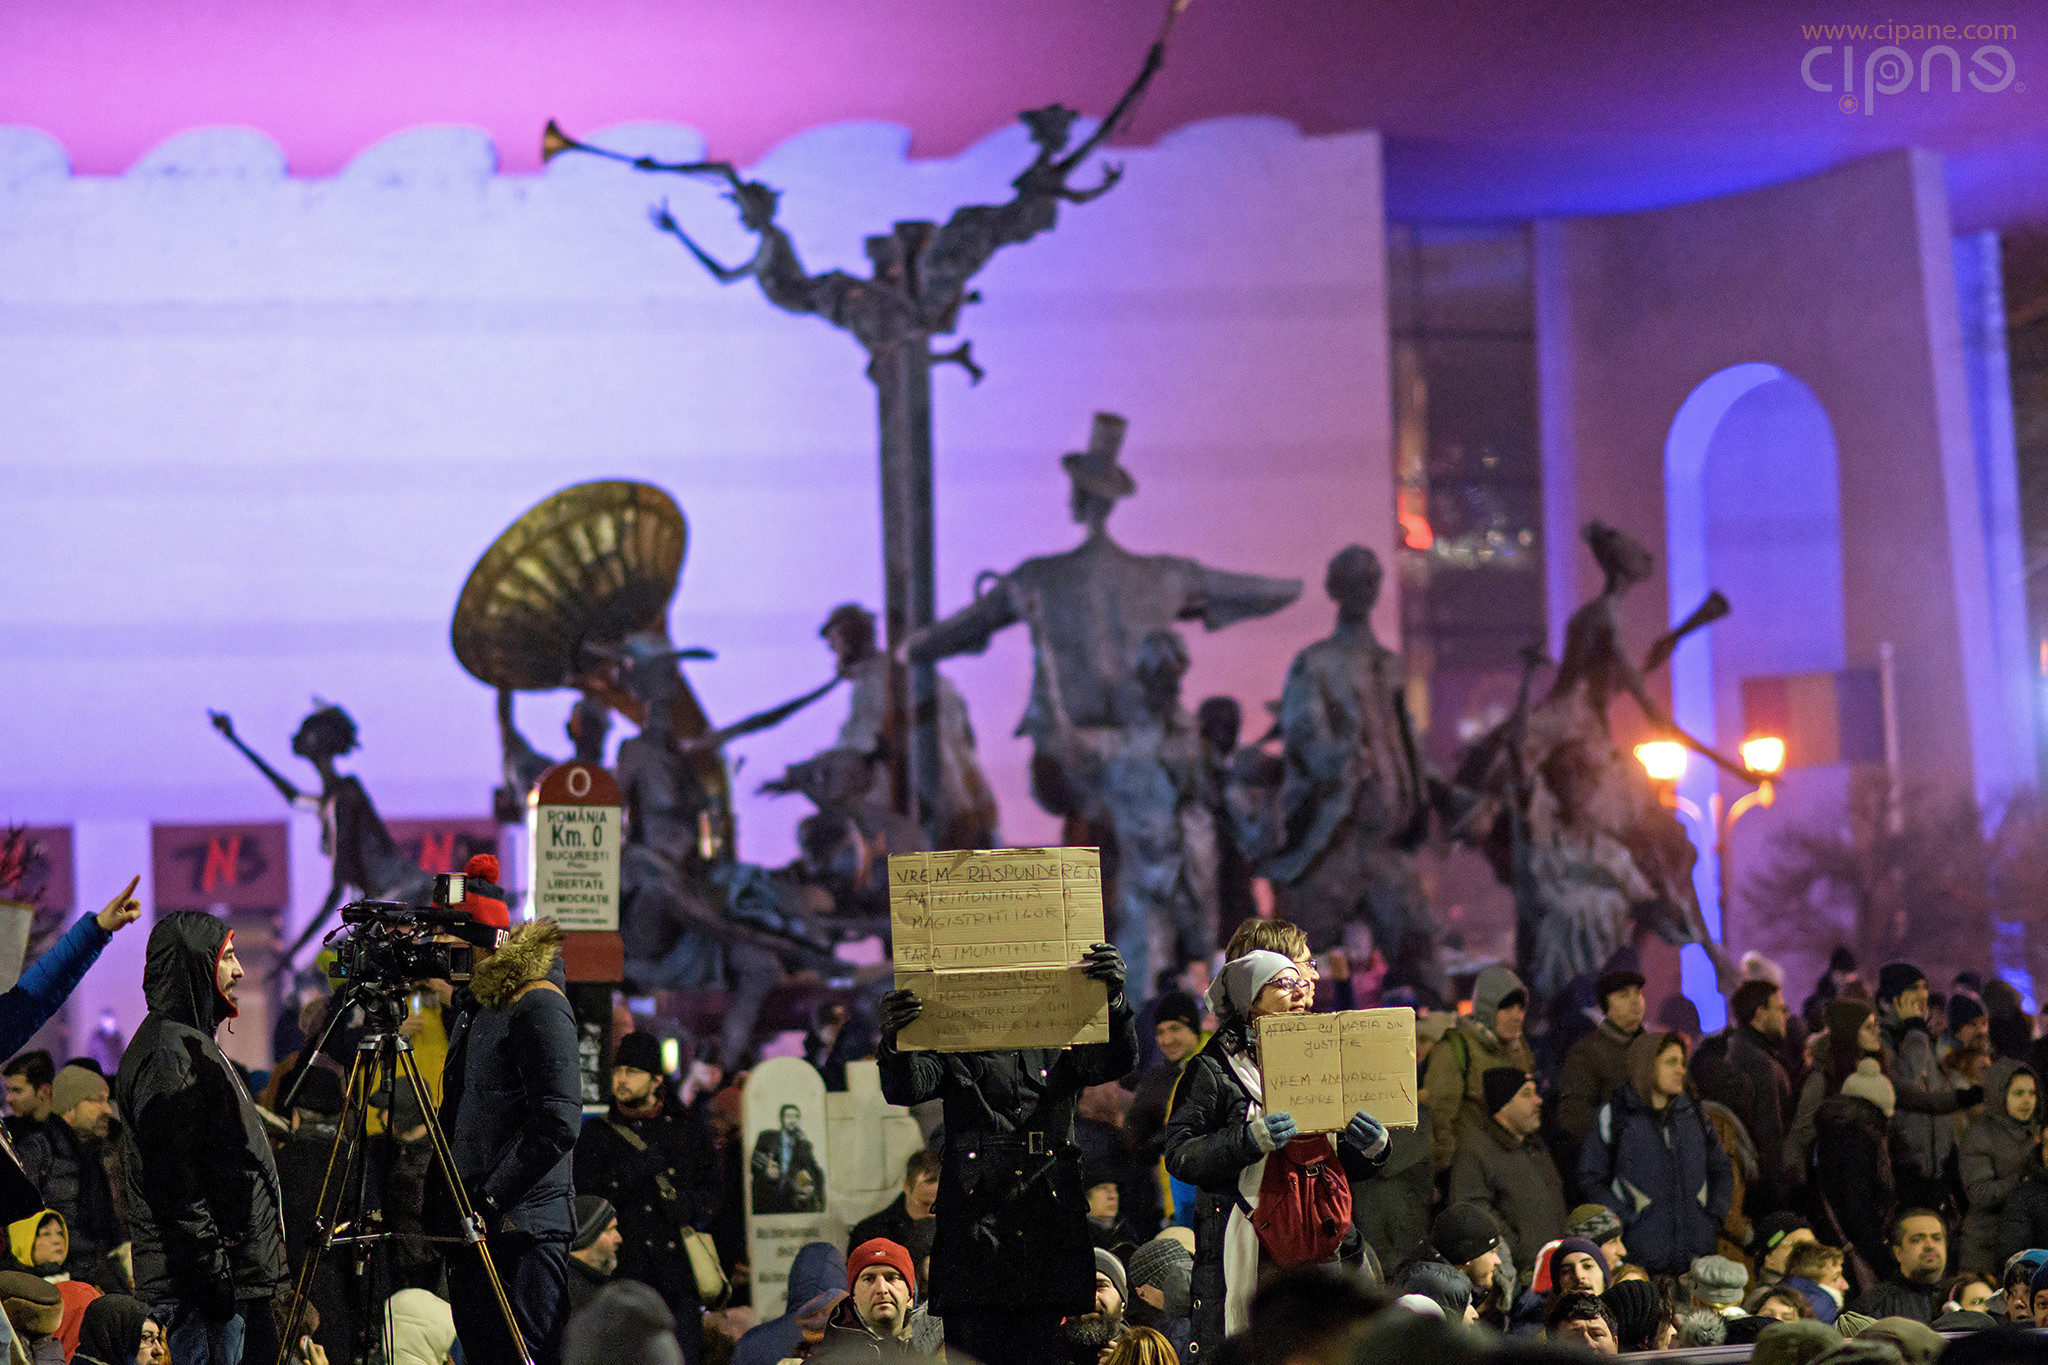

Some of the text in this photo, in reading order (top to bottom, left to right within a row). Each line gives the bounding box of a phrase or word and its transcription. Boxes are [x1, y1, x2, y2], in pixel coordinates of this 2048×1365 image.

[546, 807, 608, 824] ROMÂNIA
[551, 824, 602, 848] Km. 0
[1341, 1019, 1380, 1032] MAFIA
